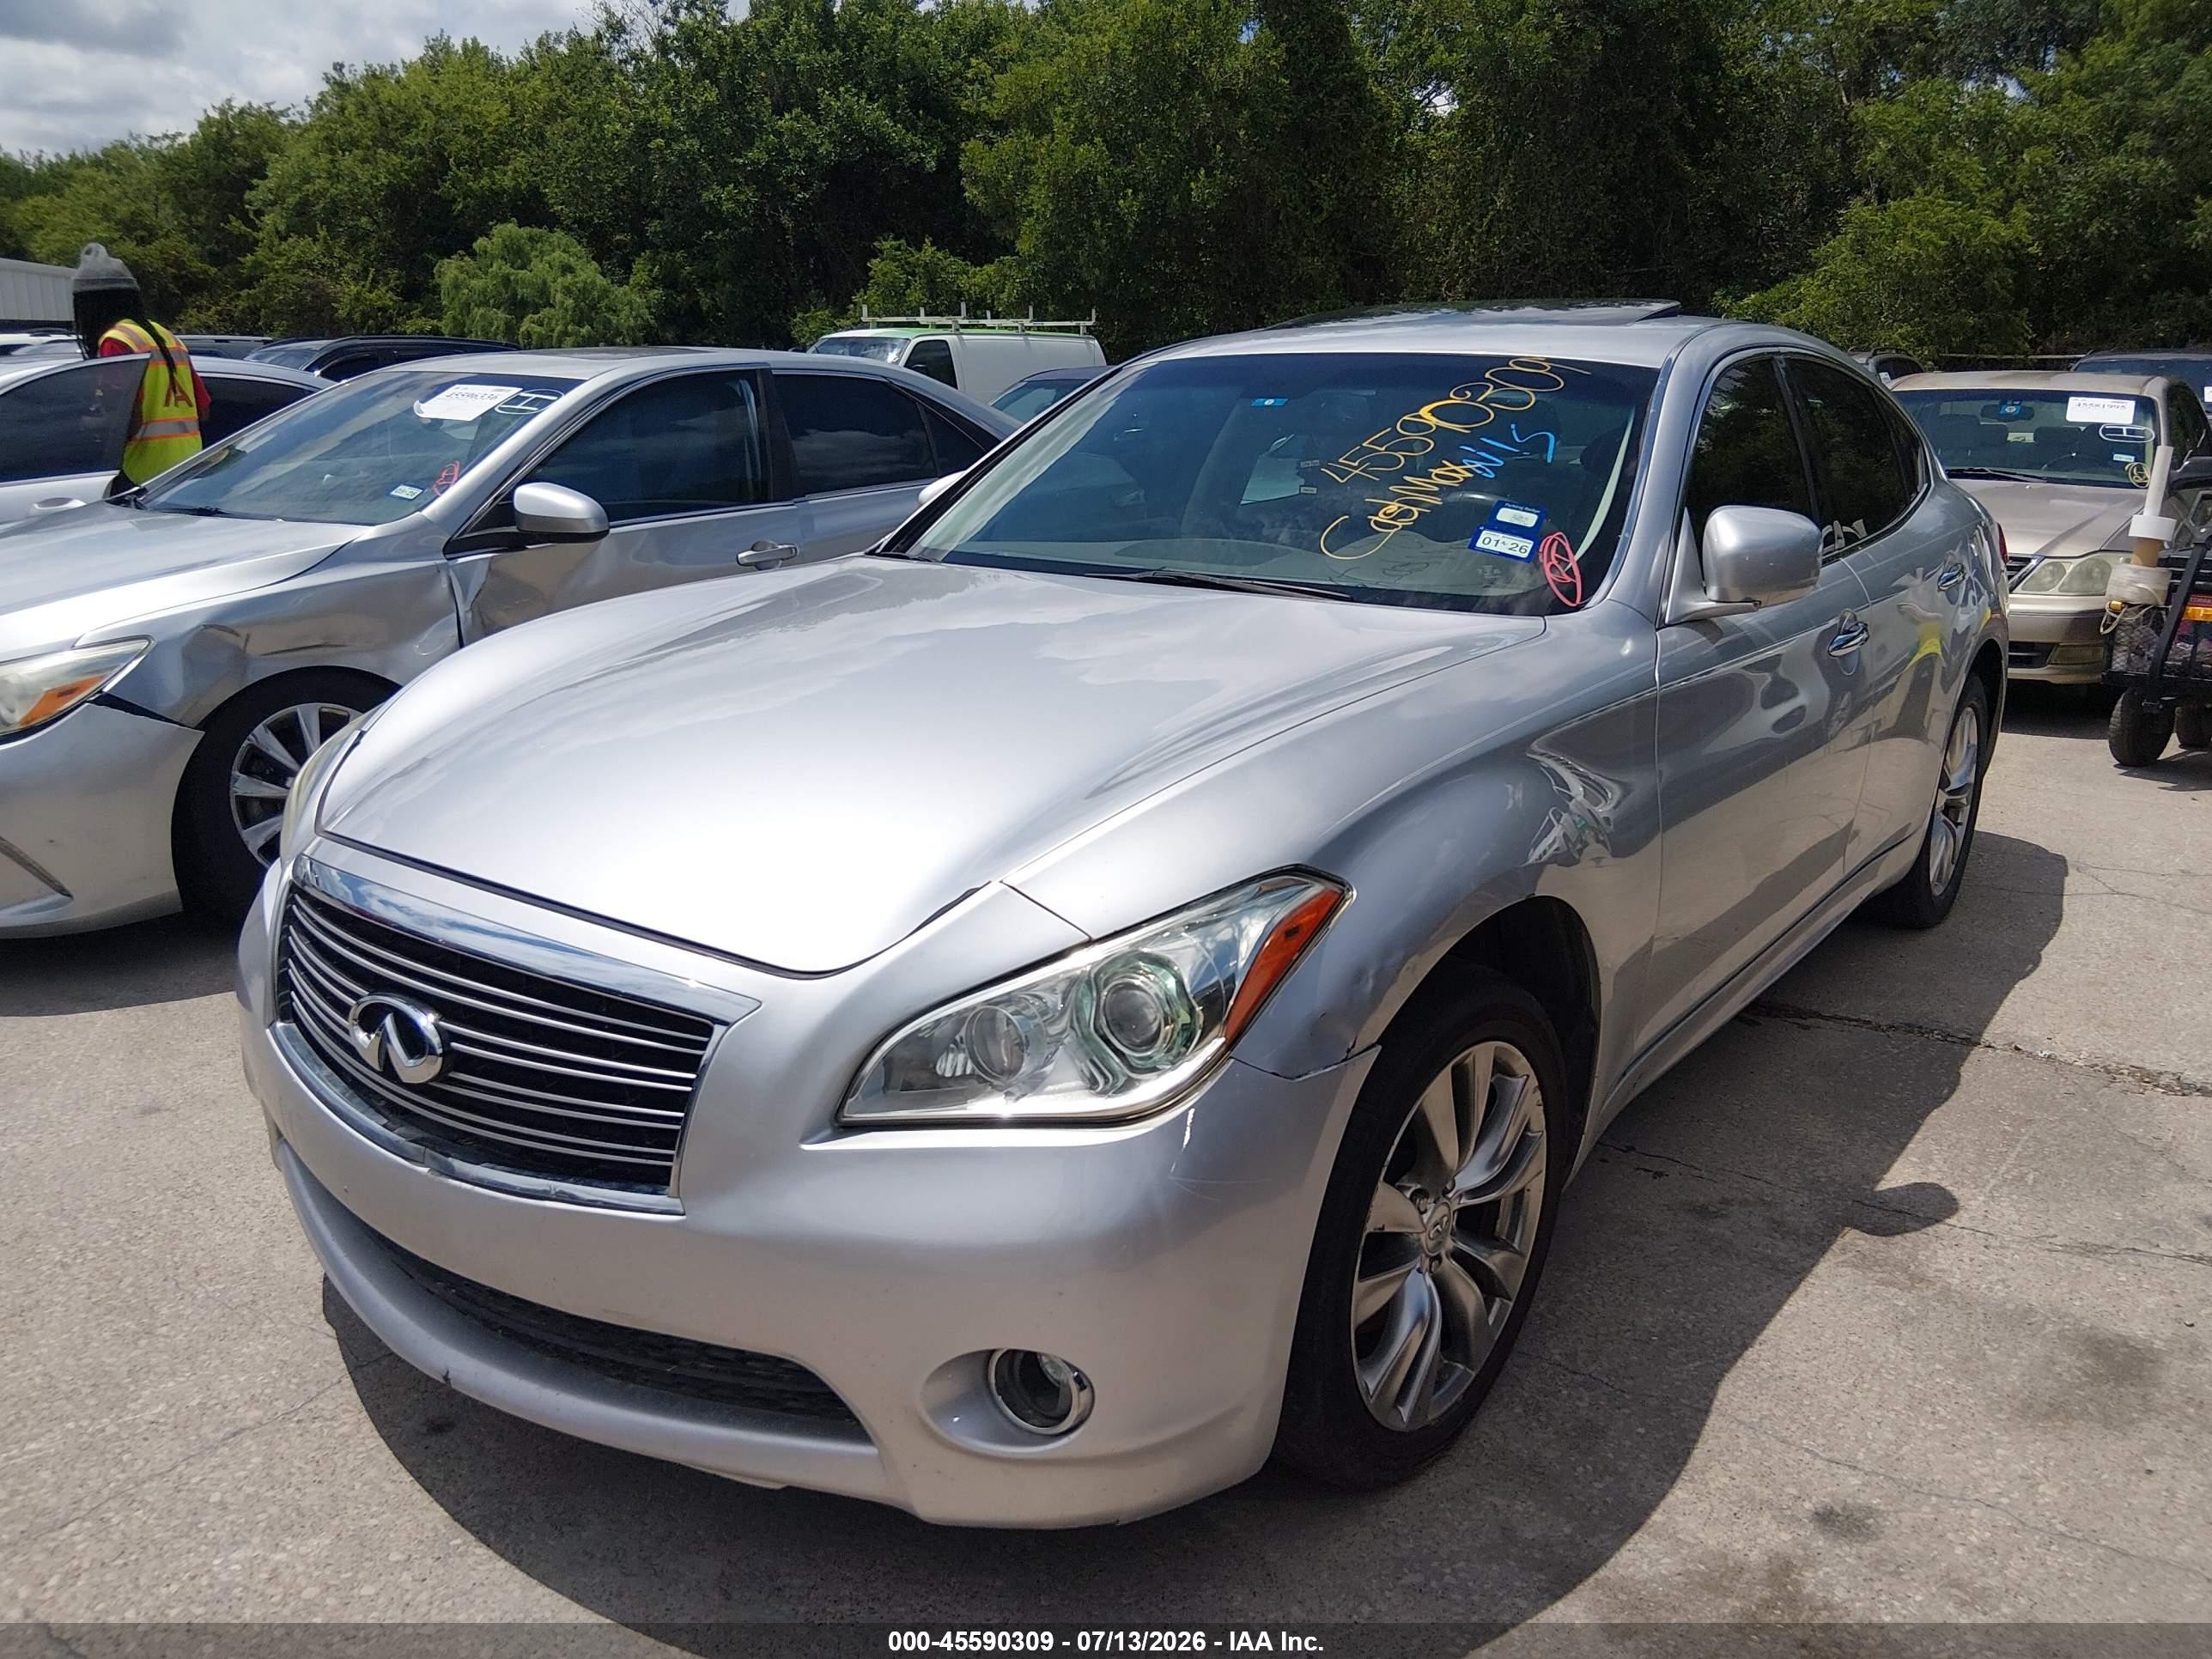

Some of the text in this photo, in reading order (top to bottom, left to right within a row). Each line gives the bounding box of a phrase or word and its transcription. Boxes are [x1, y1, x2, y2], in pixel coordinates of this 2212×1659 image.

[1321, 357, 1592, 483] 45590309
[1482, 537, 1500, 547] 01
[1508, 542, 1529, 555] 26
